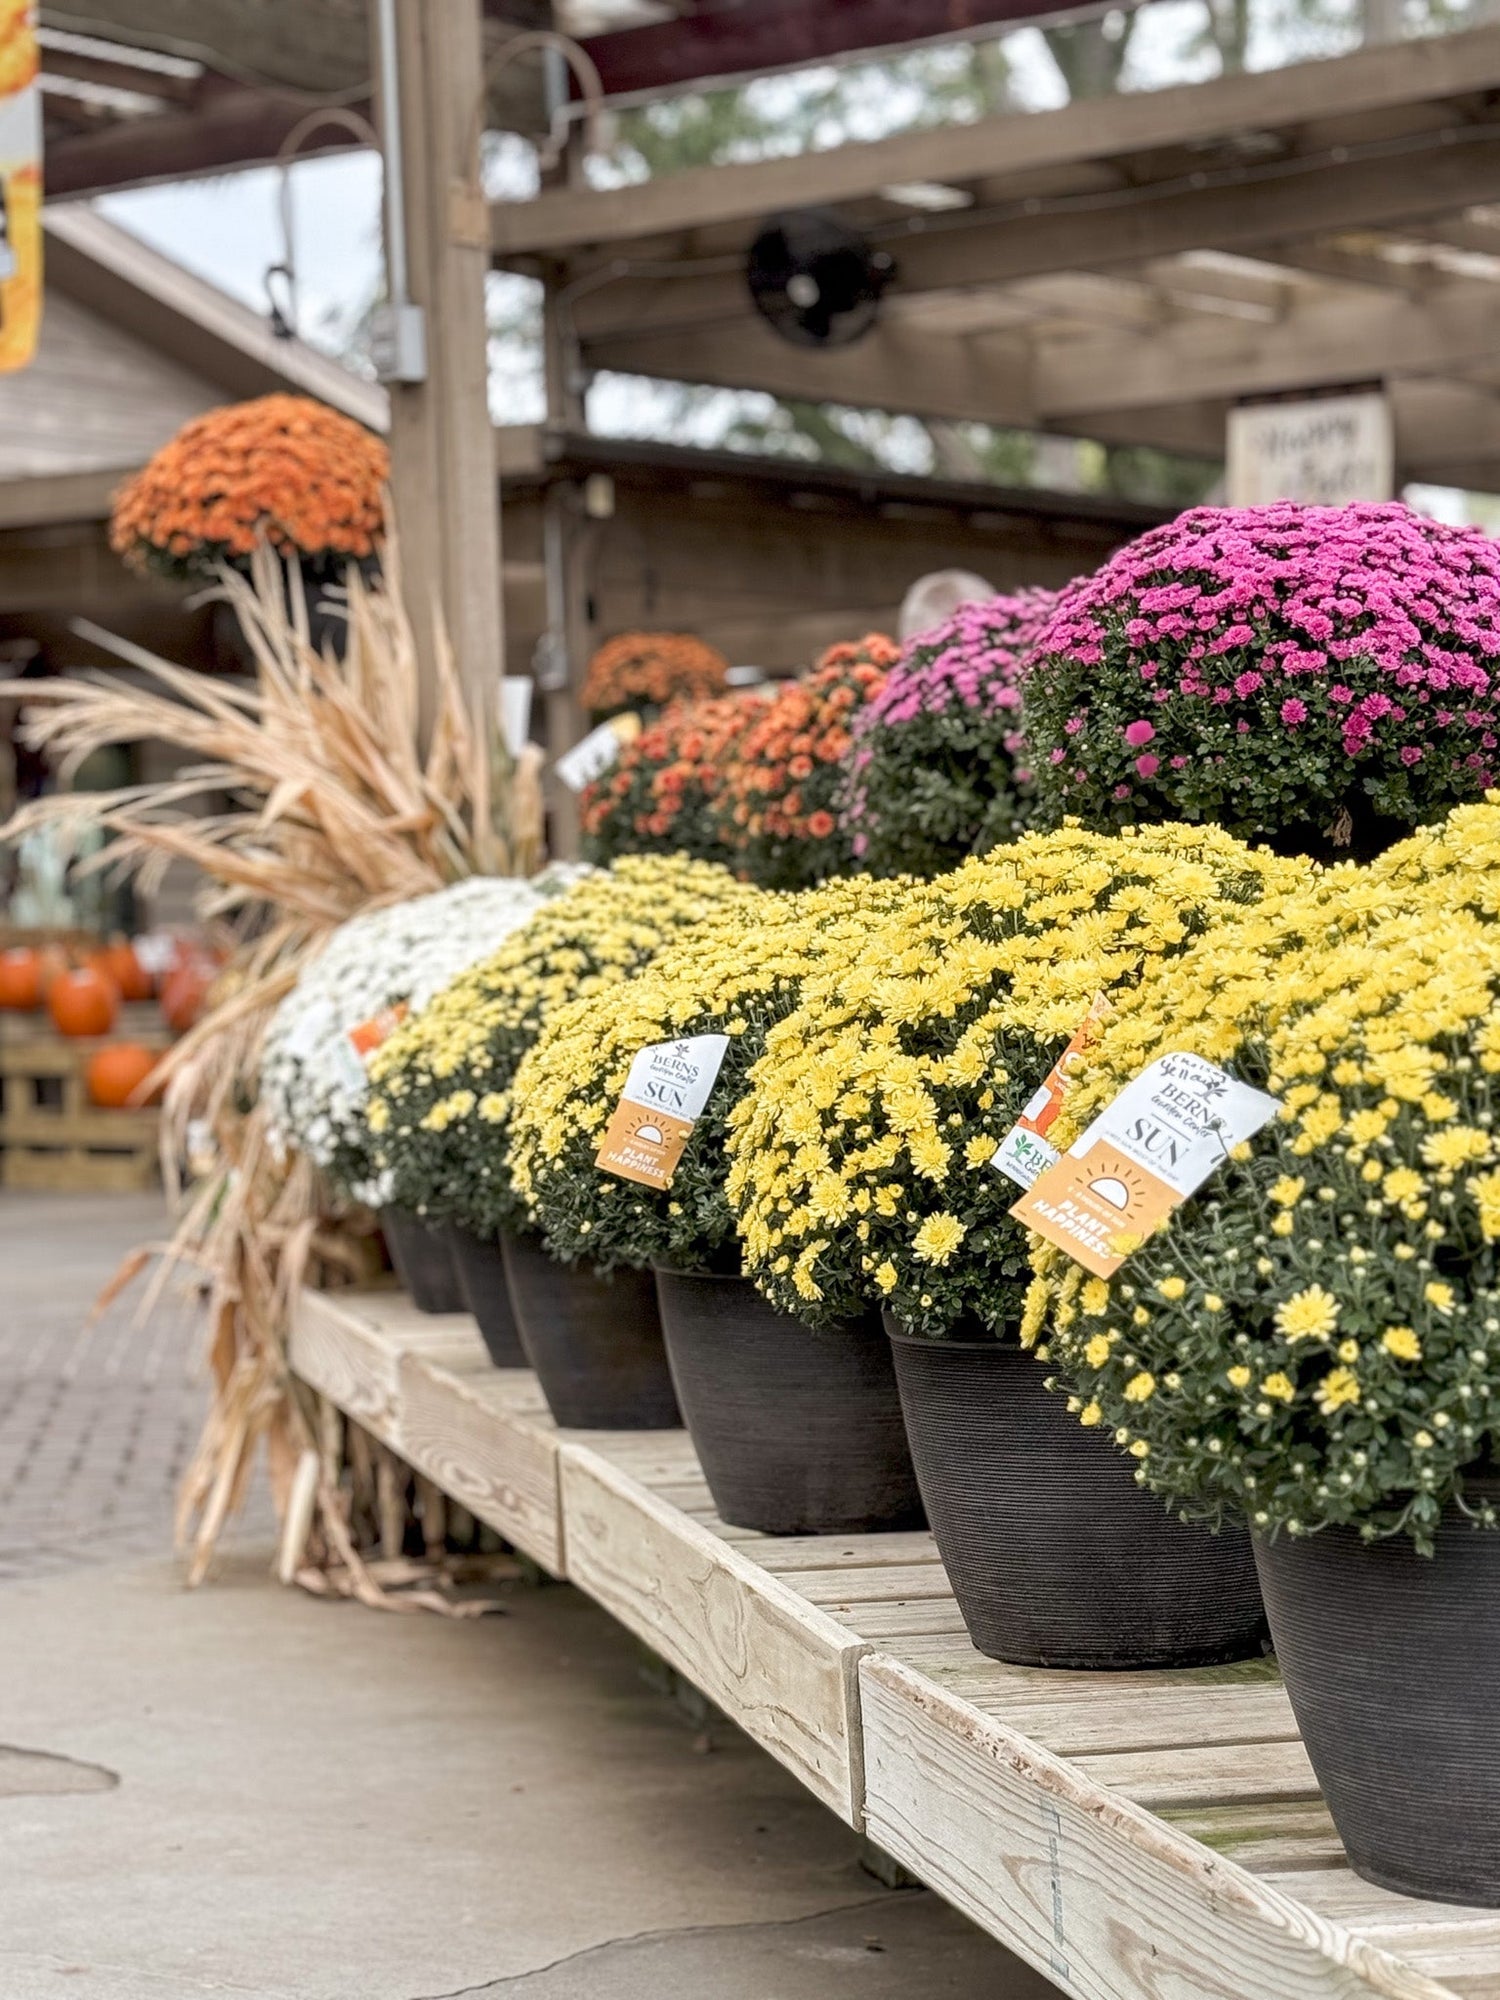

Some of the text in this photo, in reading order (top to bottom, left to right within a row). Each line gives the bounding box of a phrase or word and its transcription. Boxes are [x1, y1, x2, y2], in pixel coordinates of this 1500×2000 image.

[652, 1055, 700, 1077] BERNS
[644, 1081, 687, 1107] SUN
[1160, 1083, 1223, 1130] BERN
[622, 1147, 659, 1164] PLANT
[1126, 1118, 1190, 1167] SUN
[606, 1152, 665, 1178] HAPPINESS
[1057, 1199, 1111, 1237] PLANT
